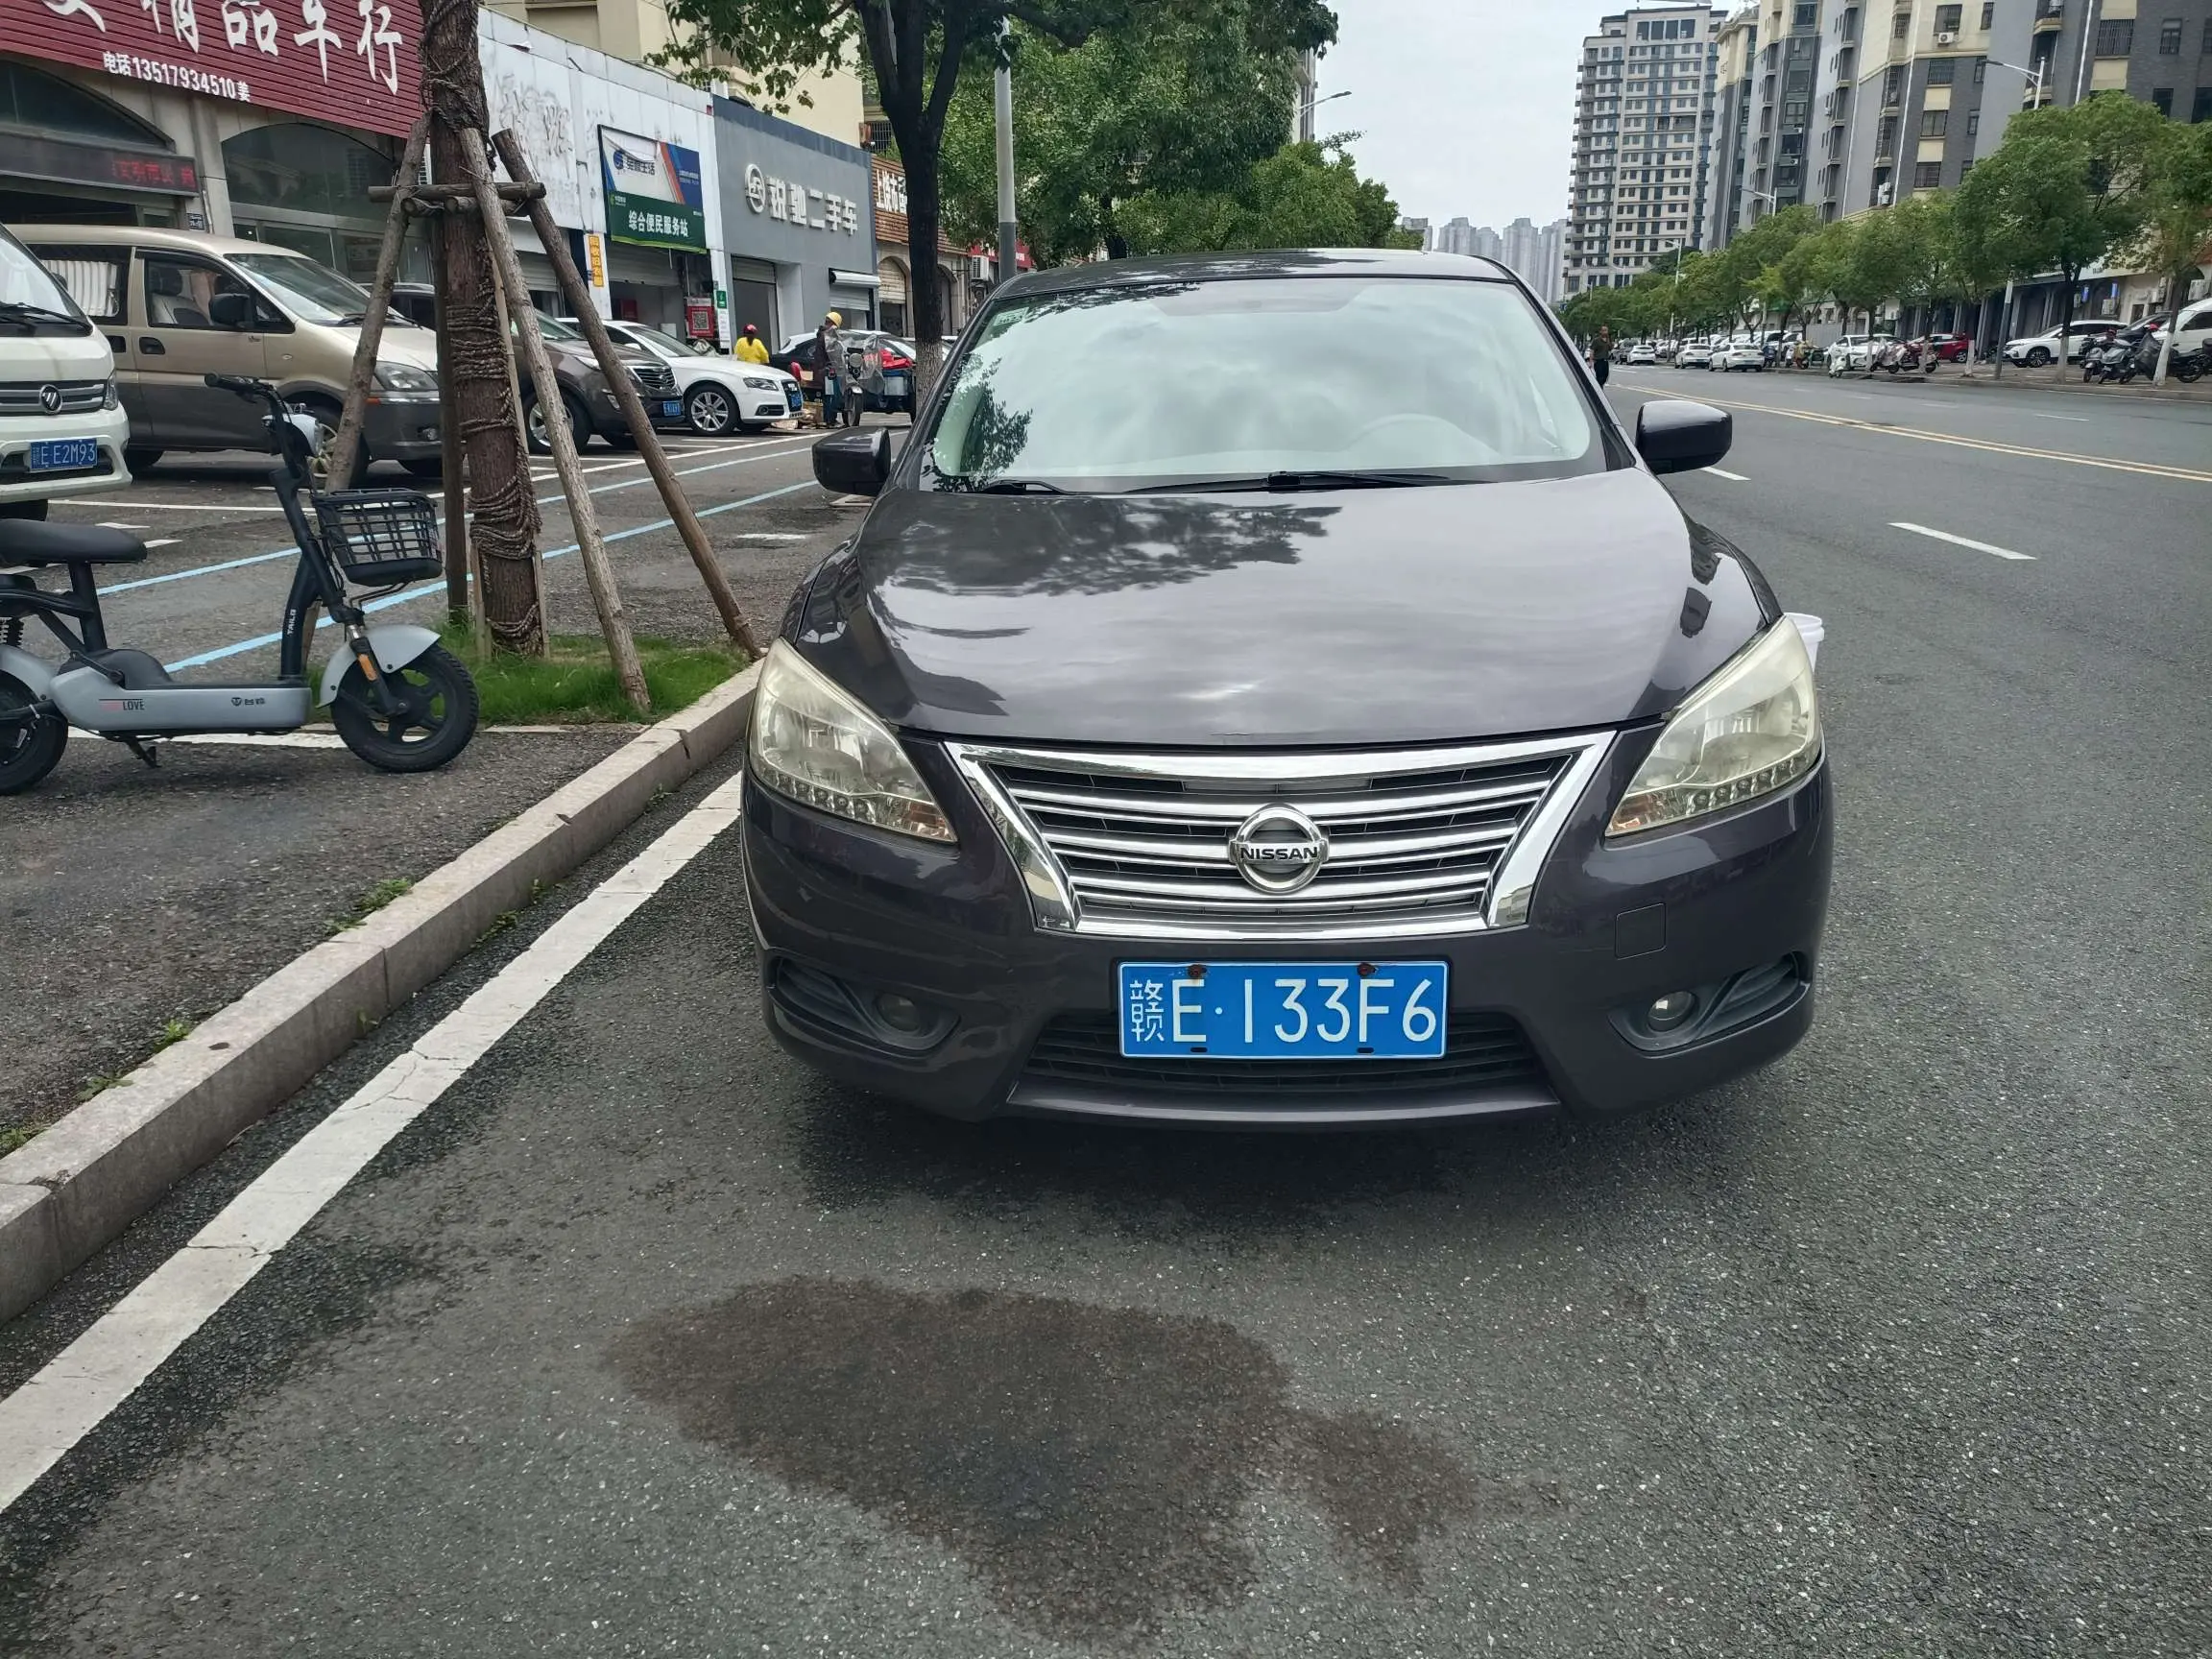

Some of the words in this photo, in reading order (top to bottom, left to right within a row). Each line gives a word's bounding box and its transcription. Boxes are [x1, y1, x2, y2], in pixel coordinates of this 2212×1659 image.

[628, 209, 689, 238] 综合便民服务站
[122, 701, 145, 710] LOVE
[1240, 846, 1318, 860] NISSAN
[1129, 977, 1437, 1044] 赣E·133F6
